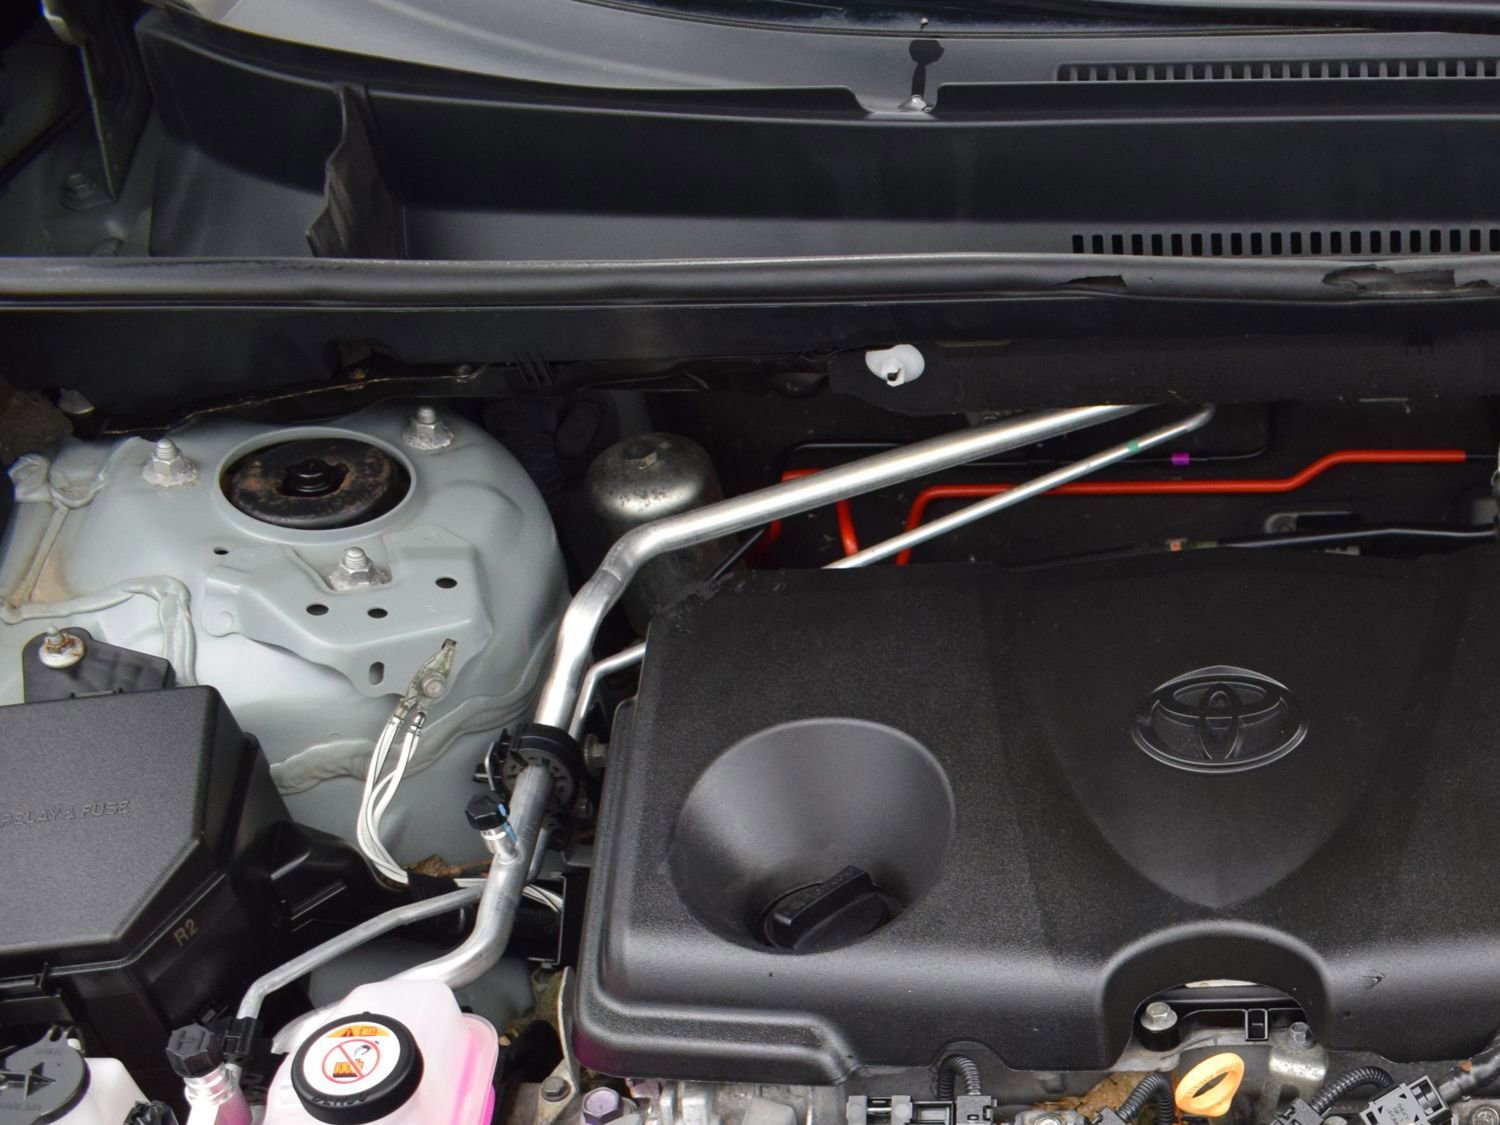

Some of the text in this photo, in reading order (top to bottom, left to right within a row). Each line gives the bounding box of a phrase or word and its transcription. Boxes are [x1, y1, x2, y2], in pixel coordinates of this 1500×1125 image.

[0, 807, 62, 828] RELAY
[82, 800, 131, 817] FUSE
[174, 918, 198, 947] R2
